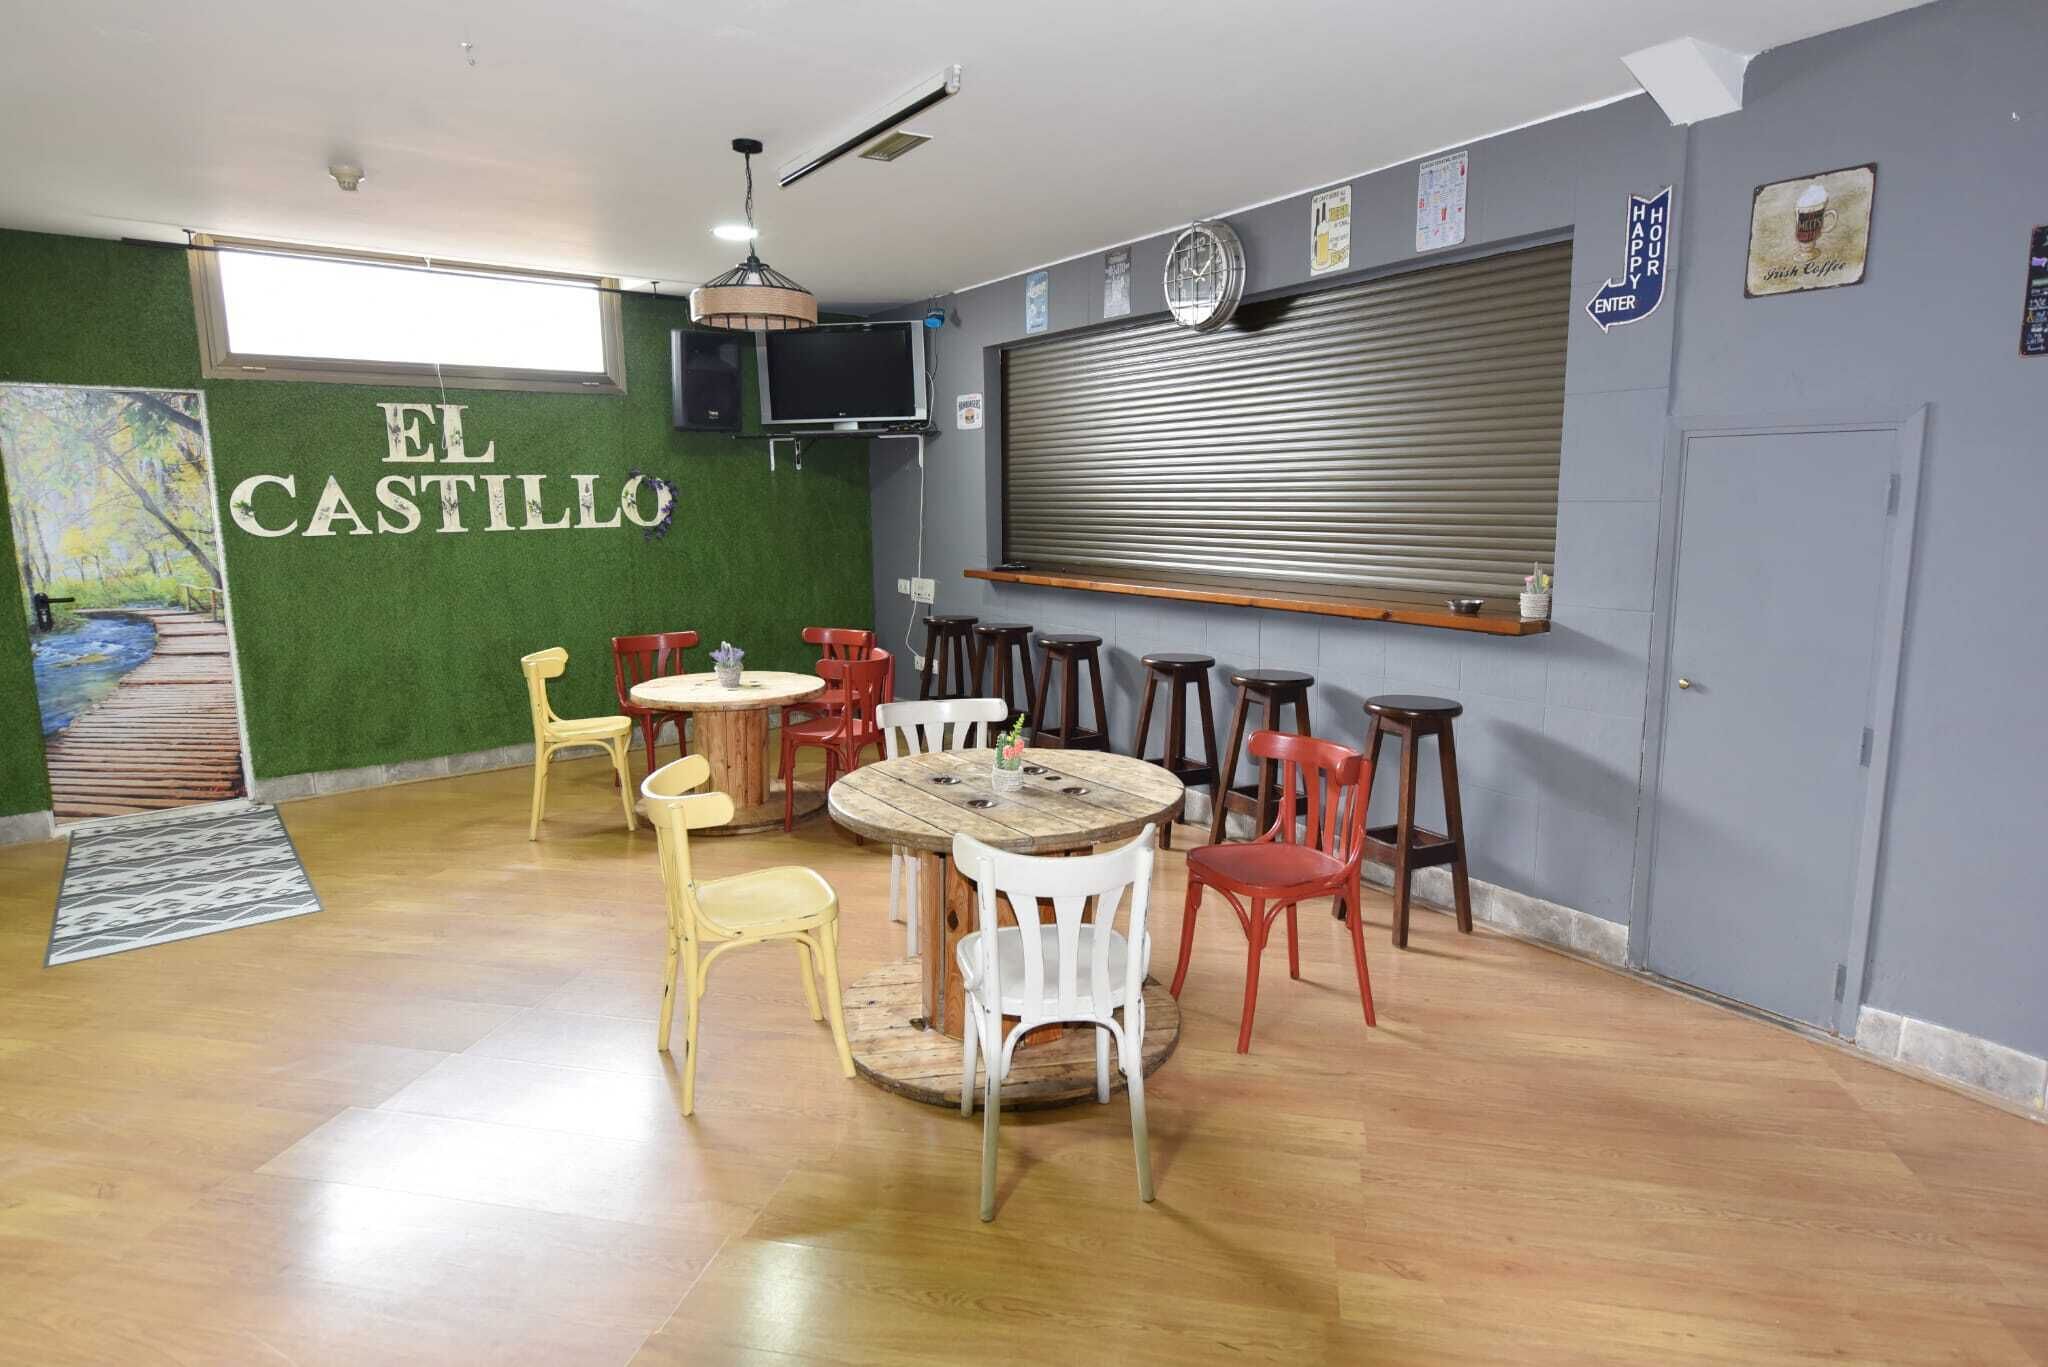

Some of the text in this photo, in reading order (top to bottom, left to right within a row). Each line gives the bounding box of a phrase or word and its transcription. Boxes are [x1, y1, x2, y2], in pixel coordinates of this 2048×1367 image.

[1630, 205, 1646, 290] HAPPY
[1647, 207, 1664, 277] HOUR
[1763, 257, 1847, 281] Irish Coffee
[1595, 295, 1635, 314] ENTER
[376, 402, 495, 464] EL
[230, 473, 674, 538] CASTILLO
